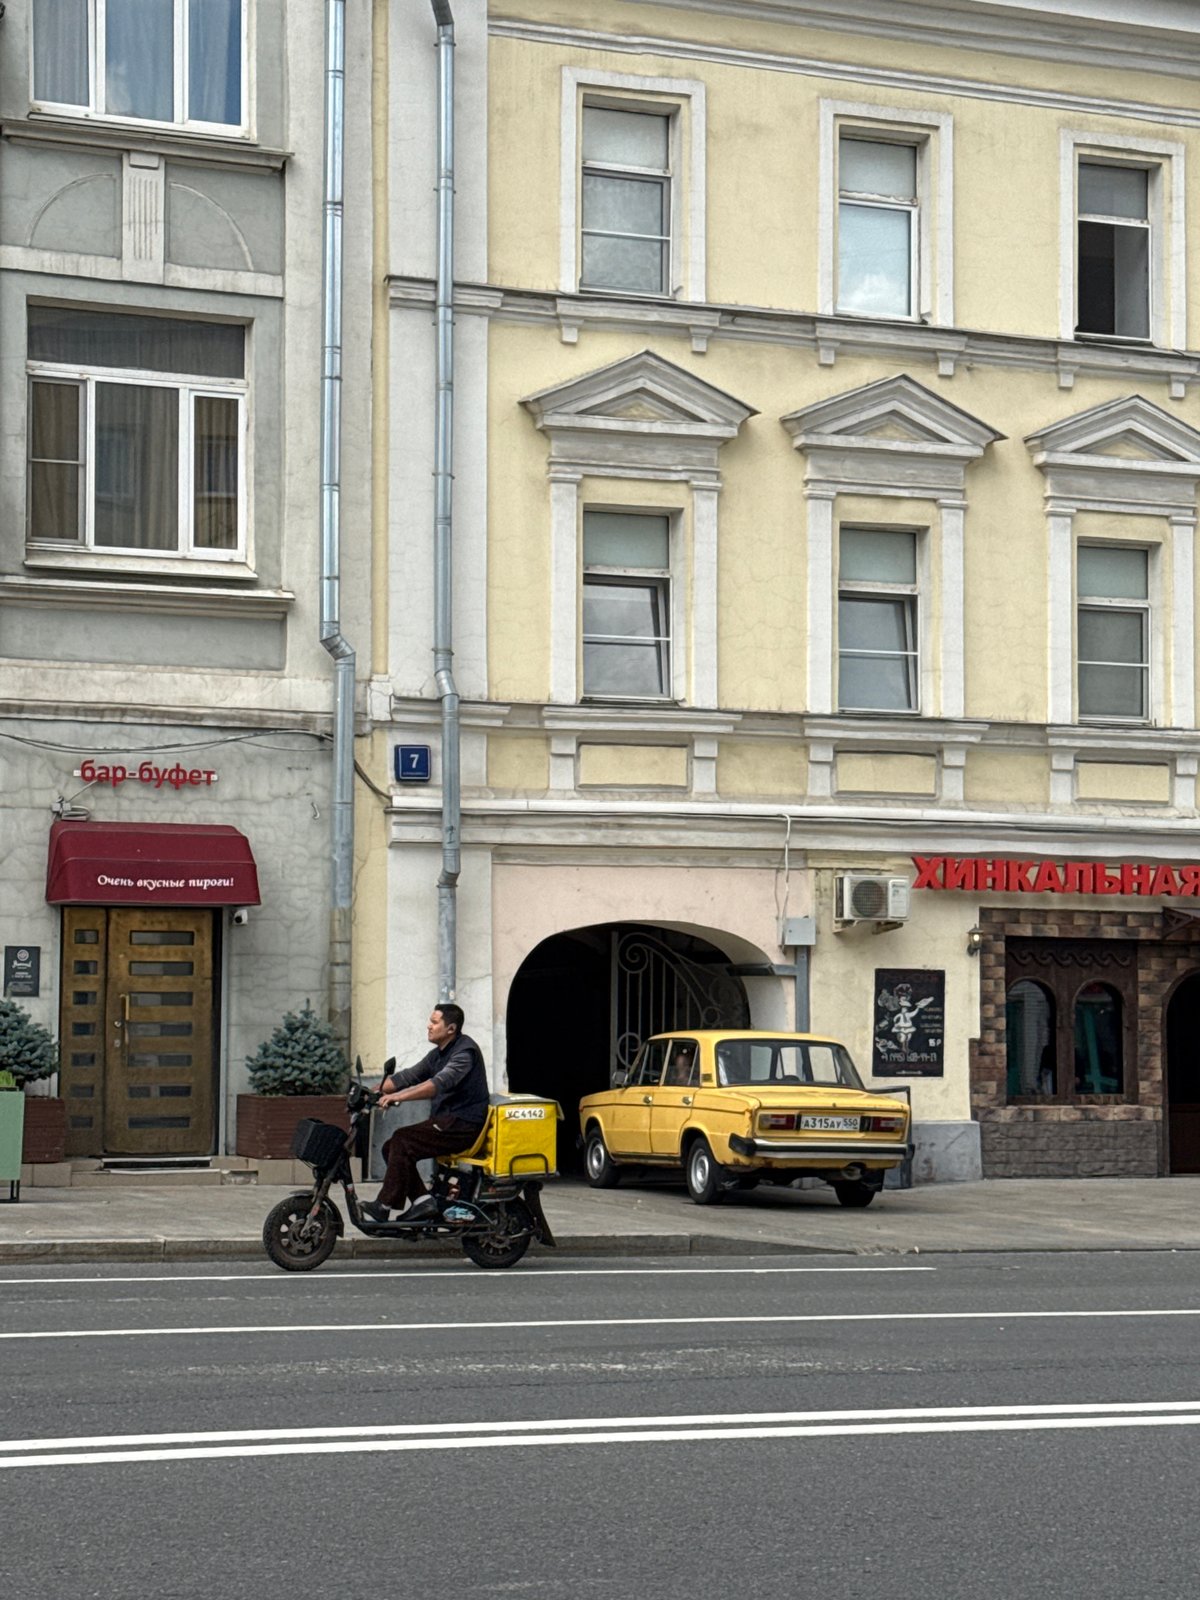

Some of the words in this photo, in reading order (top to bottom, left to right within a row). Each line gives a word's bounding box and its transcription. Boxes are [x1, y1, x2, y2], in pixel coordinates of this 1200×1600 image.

[410, 754, 419, 768] 7
[81, 759, 216, 790] бар-буфет
[97, 874, 134, 887] Очень
[137, 878, 185, 891] вкусные
[188, 877, 234, 890] пироги!
[911, 856, 1200, 896] ХИНКАЛЬНАЯ
